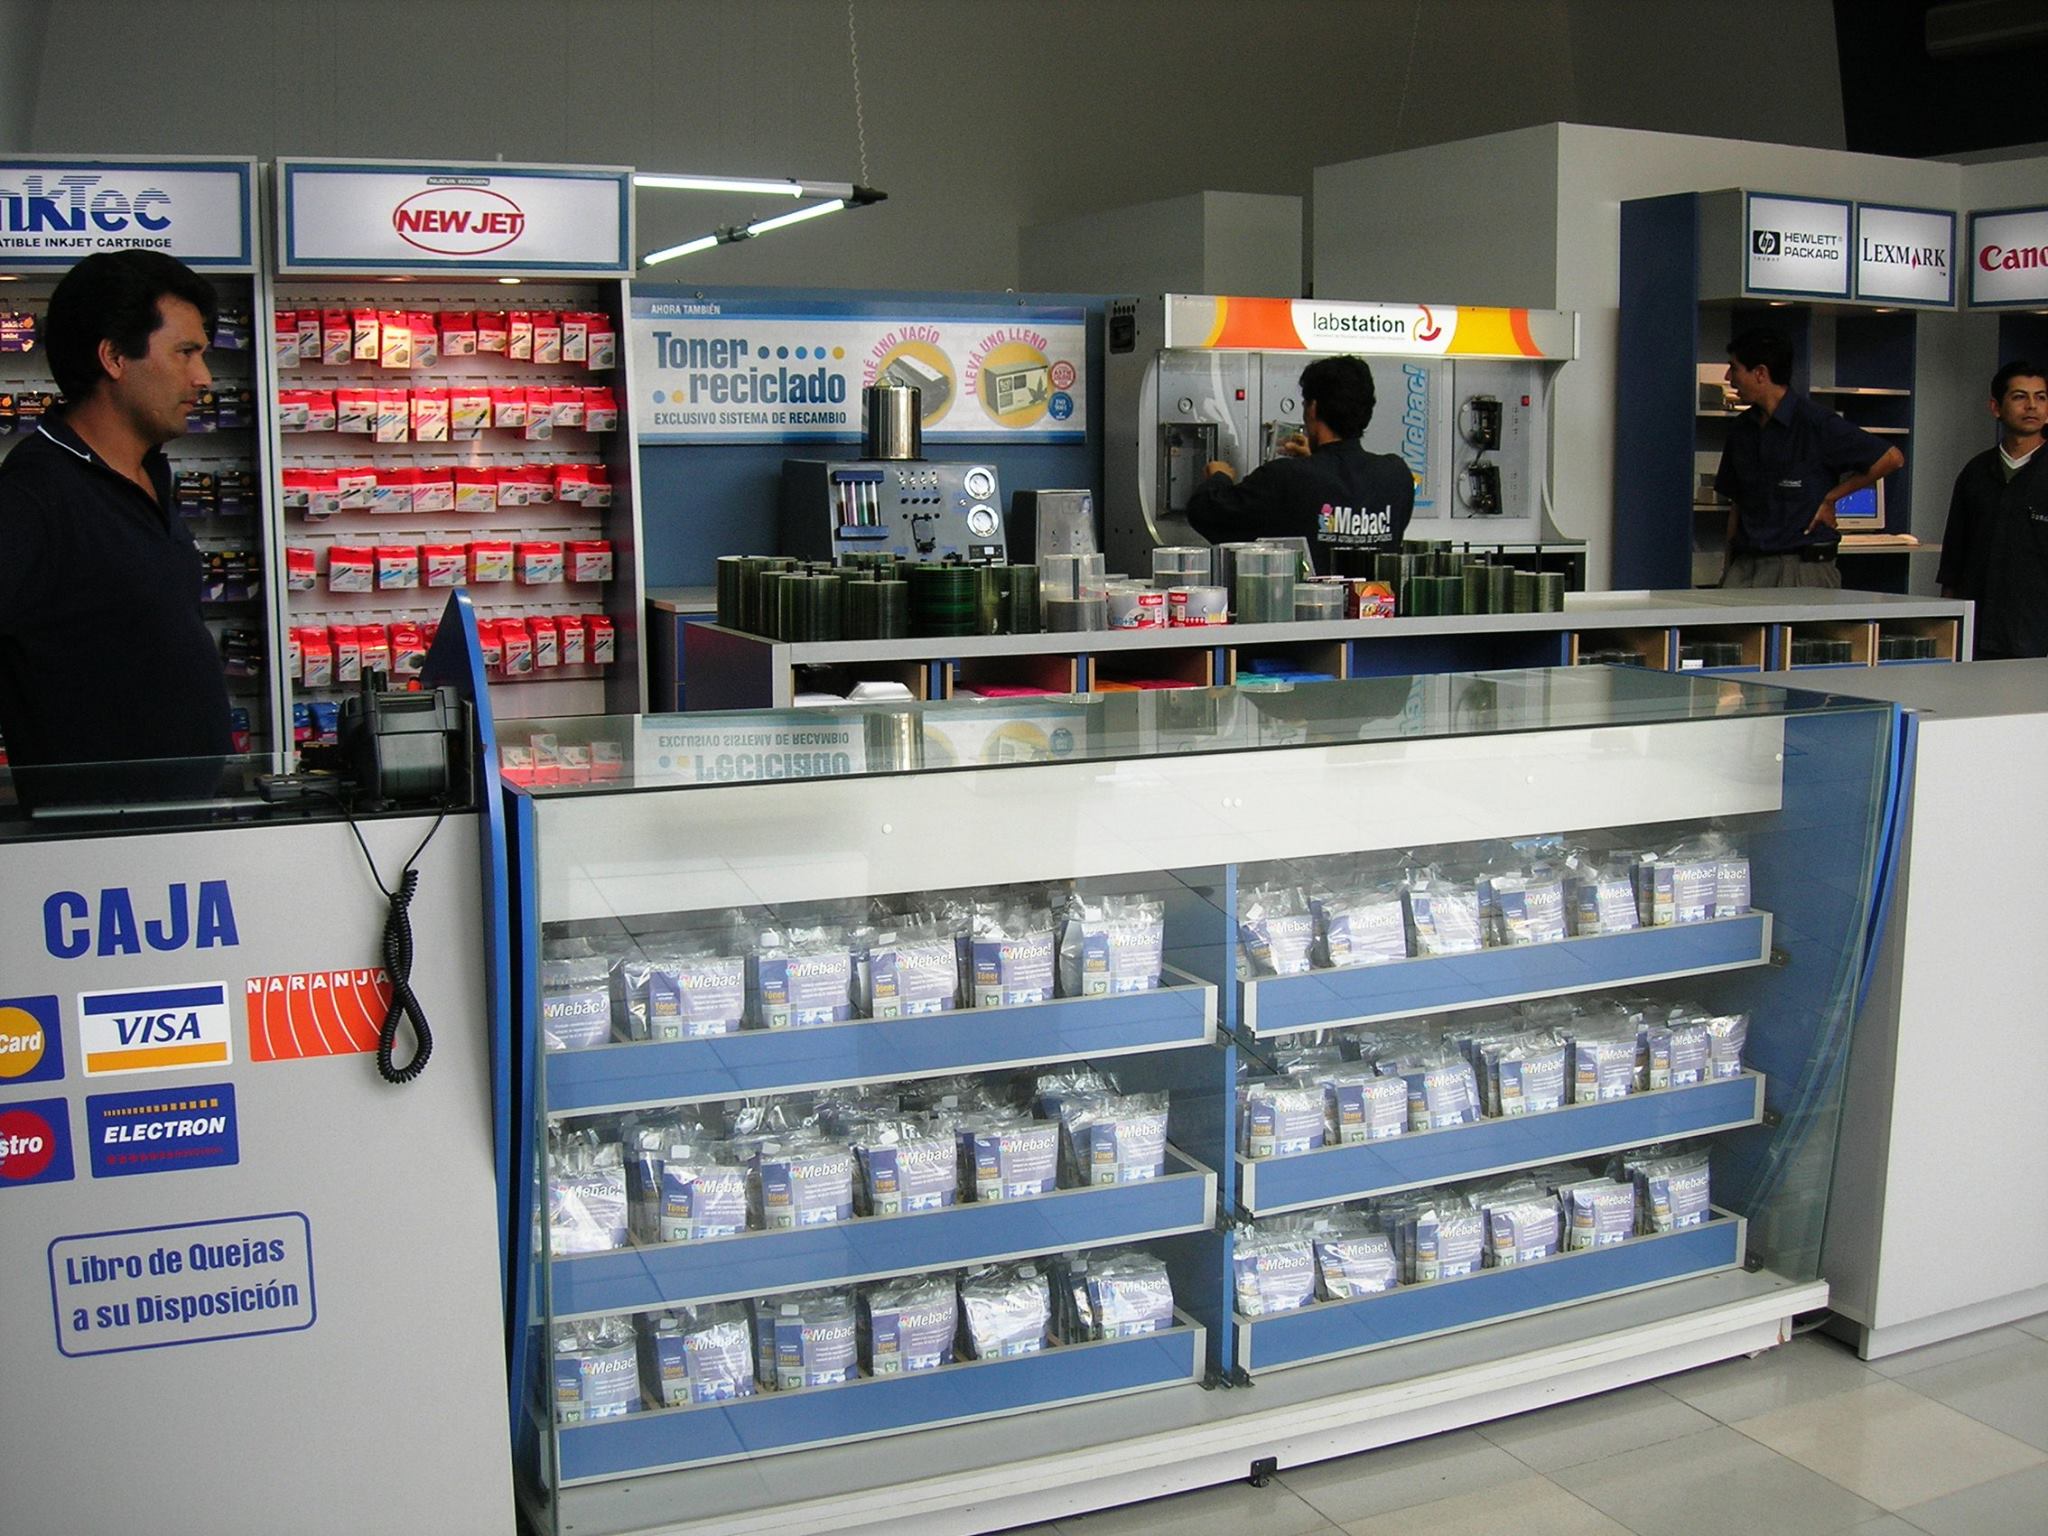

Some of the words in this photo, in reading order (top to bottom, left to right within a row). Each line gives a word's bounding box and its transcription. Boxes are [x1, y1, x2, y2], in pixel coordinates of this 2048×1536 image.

[397, 209, 471, 233] NEW
[471, 213, 525, 234] JET
[45, 238, 92, 248] INKJET
[97, 238, 171, 248] CARTRIDGE
[1784, 232, 1837, 246] HEWLETT
[1784, 247, 1839, 260] PACKARD
[1863, 238, 1946, 269] LEXMARK
[651, 304, 681, 315] AHORA
[683, 303, 721, 315] TAMBIÉN
[1313, 312, 1405, 333] labstation
[652, 331, 748, 369] Toner
[863, 359, 879, 389] RAÉ
[872, 333, 897, 358] UNO
[899, 325, 941, 345] VACÍO
[964, 350, 984, 396] LLEVÁ
[979, 329, 1006, 352] UNO
[1009, 327, 1049, 351] LLENO
[689, 367, 846, 404] reciclado
[654, 412, 716, 425] EXCLUSIVO
[719, 412, 767, 424] SISTEMA
[772, 412, 785, 424] DE
[789, 411, 846, 424] RECAMBIO
[1402, 363, 1426, 474] Mebac!
[1334, 505, 1391, 535] Mebac!
[1681, 866, 1717, 882] Mebac!
[1717, 866, 1746, 880] ebac!
[43, 879, 239, 959] CAJA
[905, 951, 952, 969] Mebac!
[1010, 943, 1052, 960] Mebac!
[798, 959, 847, 977] Mebac!
[246, 970, 391, 994] NARANJA
[690, 972, 742, 989] Mebac!
[550, 1000, 608, 1018] Mebac!
[113, 1012, 201, 1045] VISA
[104, 1117, 226, 1144] ELECTRON
[1124, 1119, 1166, 1139] Mebac!
[1010, 1134, 1055, 1153] Mebac!
[906, 1147, 954, 1166] Mebac!
[801, 1159, 849, 1179] Mebac!
[1444, 1223, 1482, 1238] Mebac!
[1347, 1241, 1388, 1258] Mebac!
[66, 1254, 142, 1286] Libro
[149, 1247, 183, 1276] de
[189, 1238, 285, 1272] Quejas
[1266, 1255, 1310, 1272] Mebac!
[73, 1307, 89, 1331] a
[96, 1303, 130, 1329] su
[136, 1279, 299, 1324] Disposición
[910, 1309, 953, 1328] Mebac!
[593, 1357, 636, 1375] Mebac!
